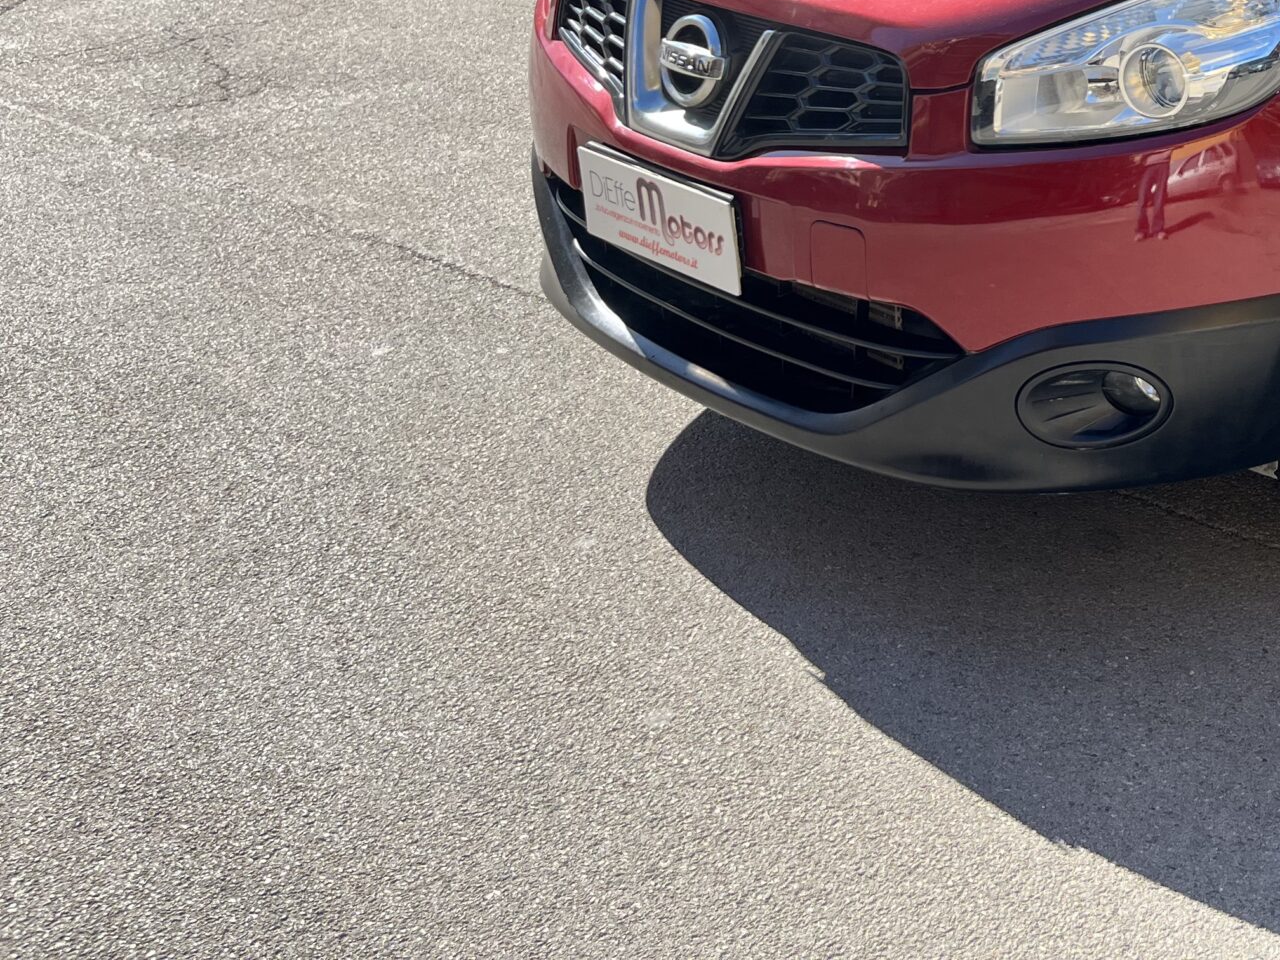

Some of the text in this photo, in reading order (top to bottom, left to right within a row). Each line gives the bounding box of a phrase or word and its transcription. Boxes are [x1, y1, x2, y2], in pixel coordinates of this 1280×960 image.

[661, 45, 711, 74] NISSAN
[589, 170, 636, 211] DiEffe
[636, 177, 724, 256] Motors
